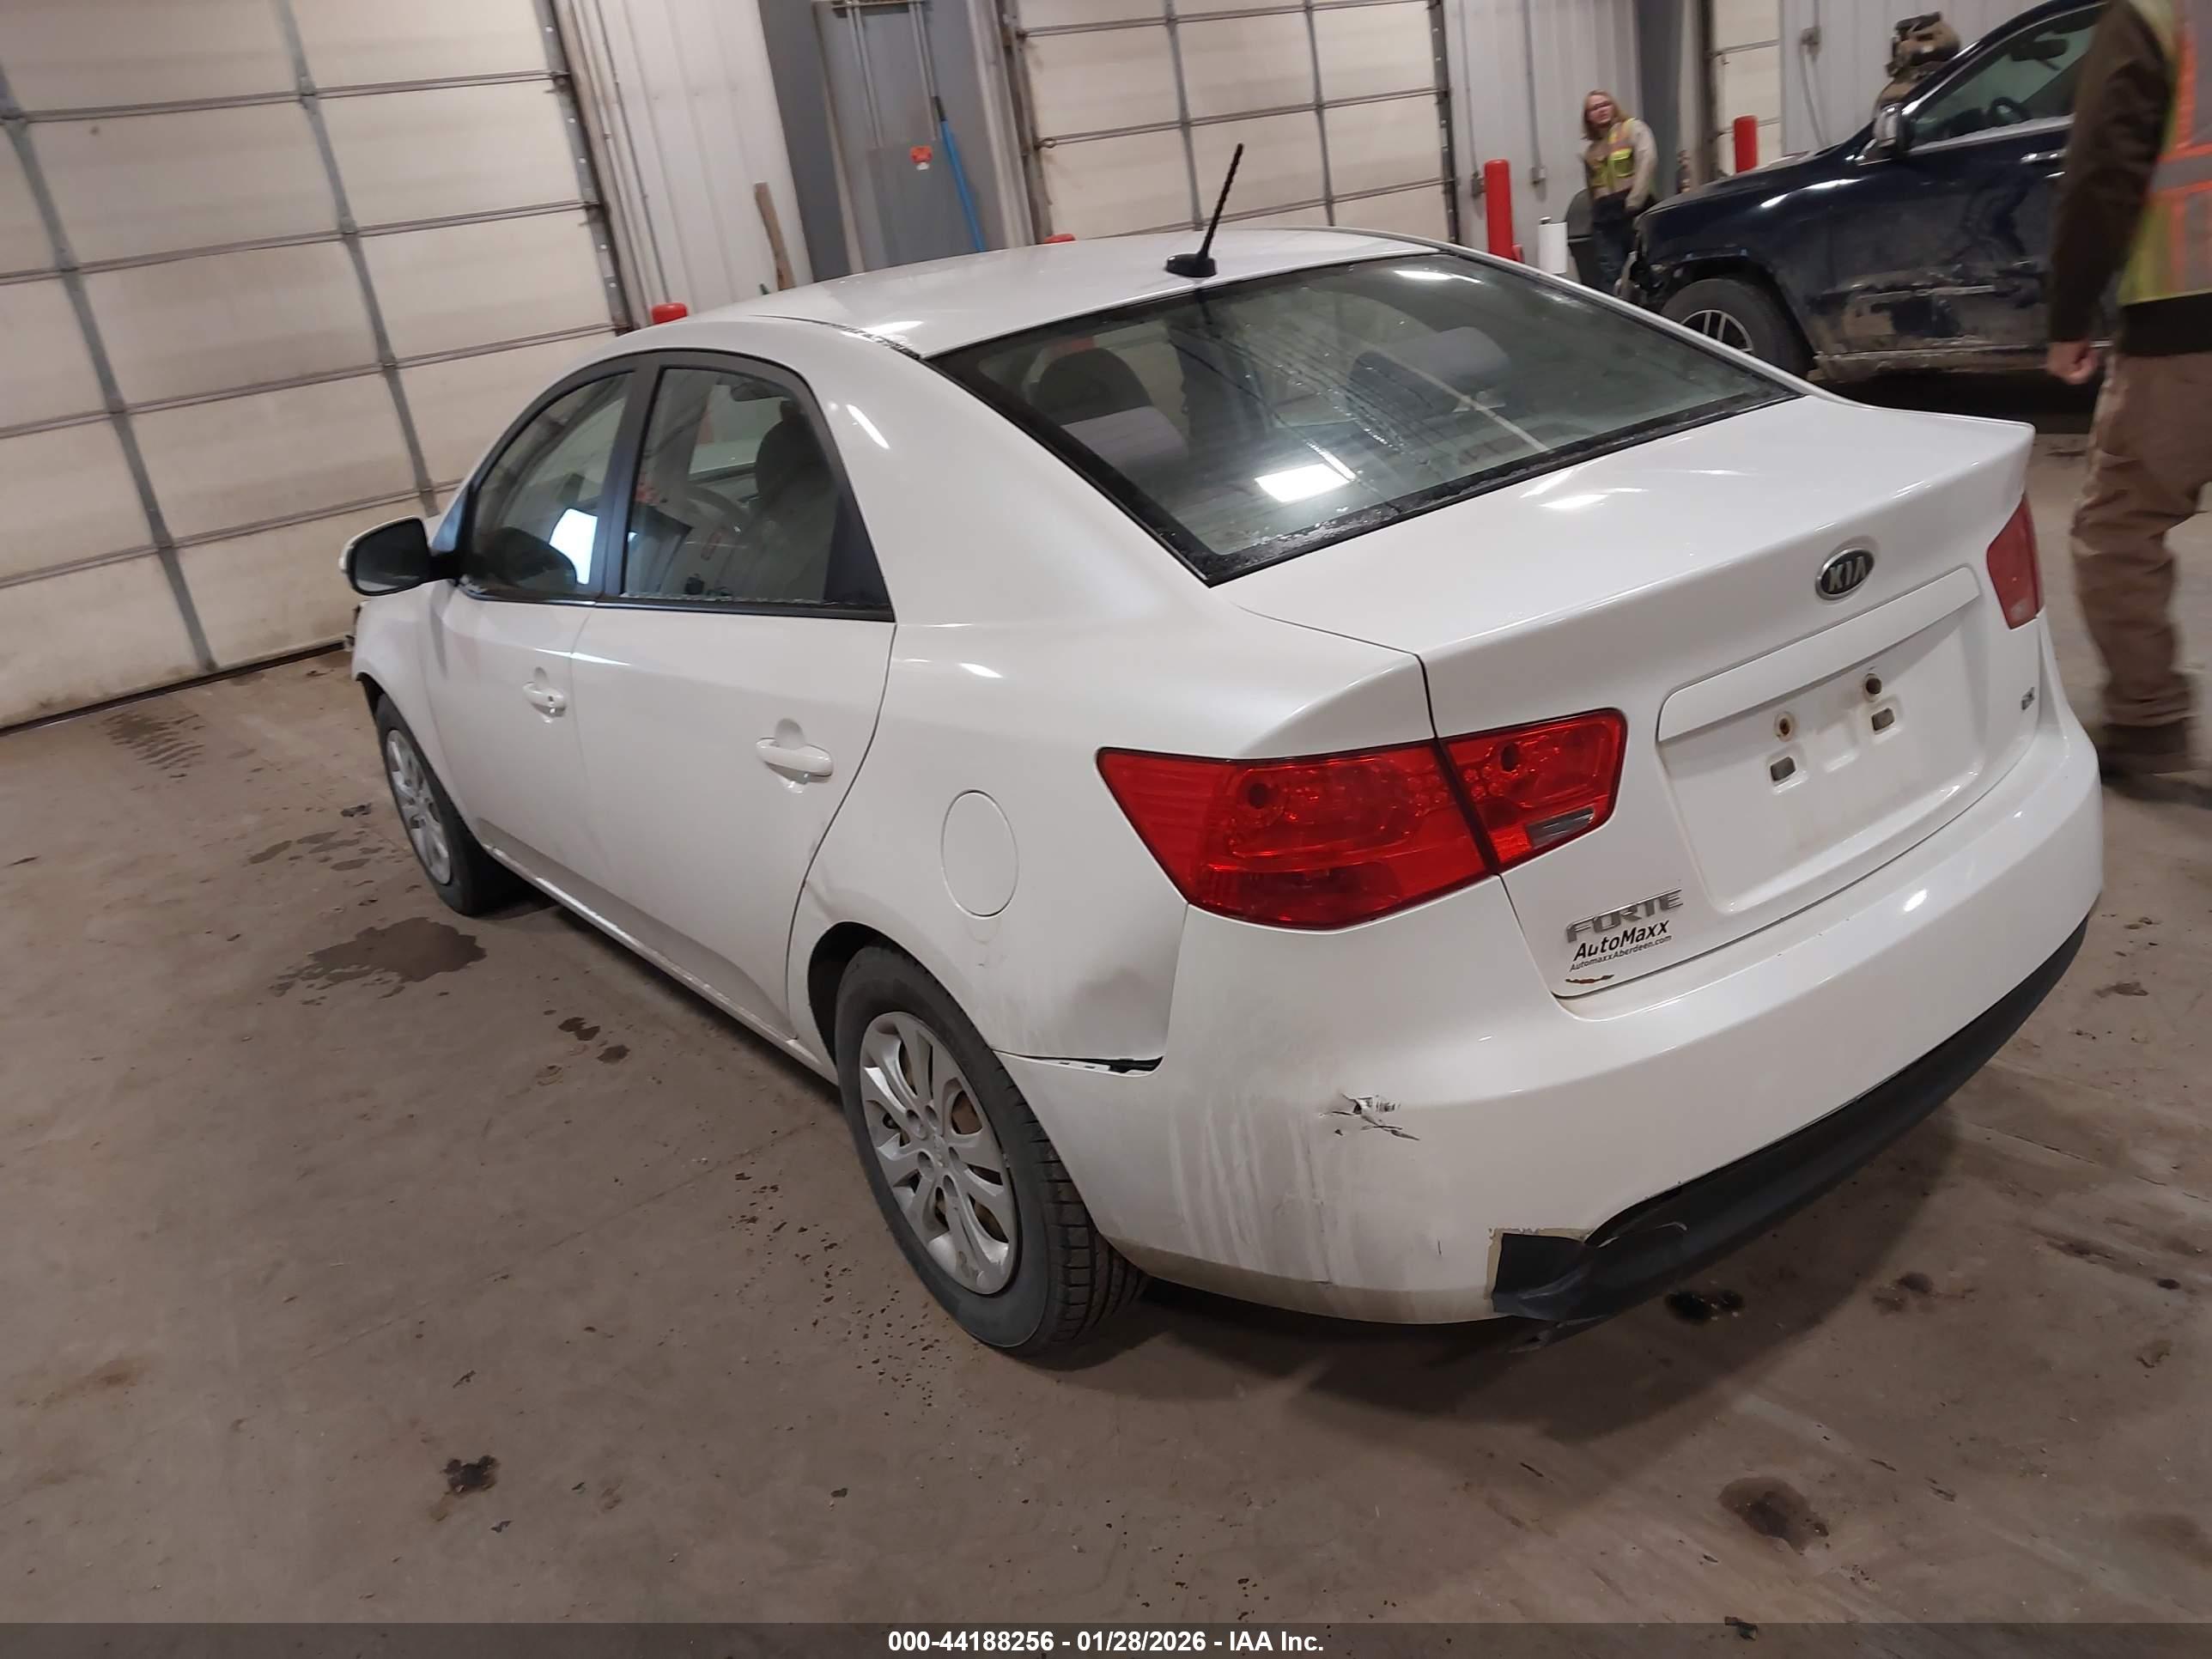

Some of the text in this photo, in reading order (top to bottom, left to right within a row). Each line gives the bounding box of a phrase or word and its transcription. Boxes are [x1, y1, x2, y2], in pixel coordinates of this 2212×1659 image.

[1827, 556, 1867, 592] KIA
[1565, 887, 1684, 943] FORTE
[1569, 934, 1672, 972] AutomaxxAberdeen.com
[1573, 920, 1669, 961] AutoMaxx
